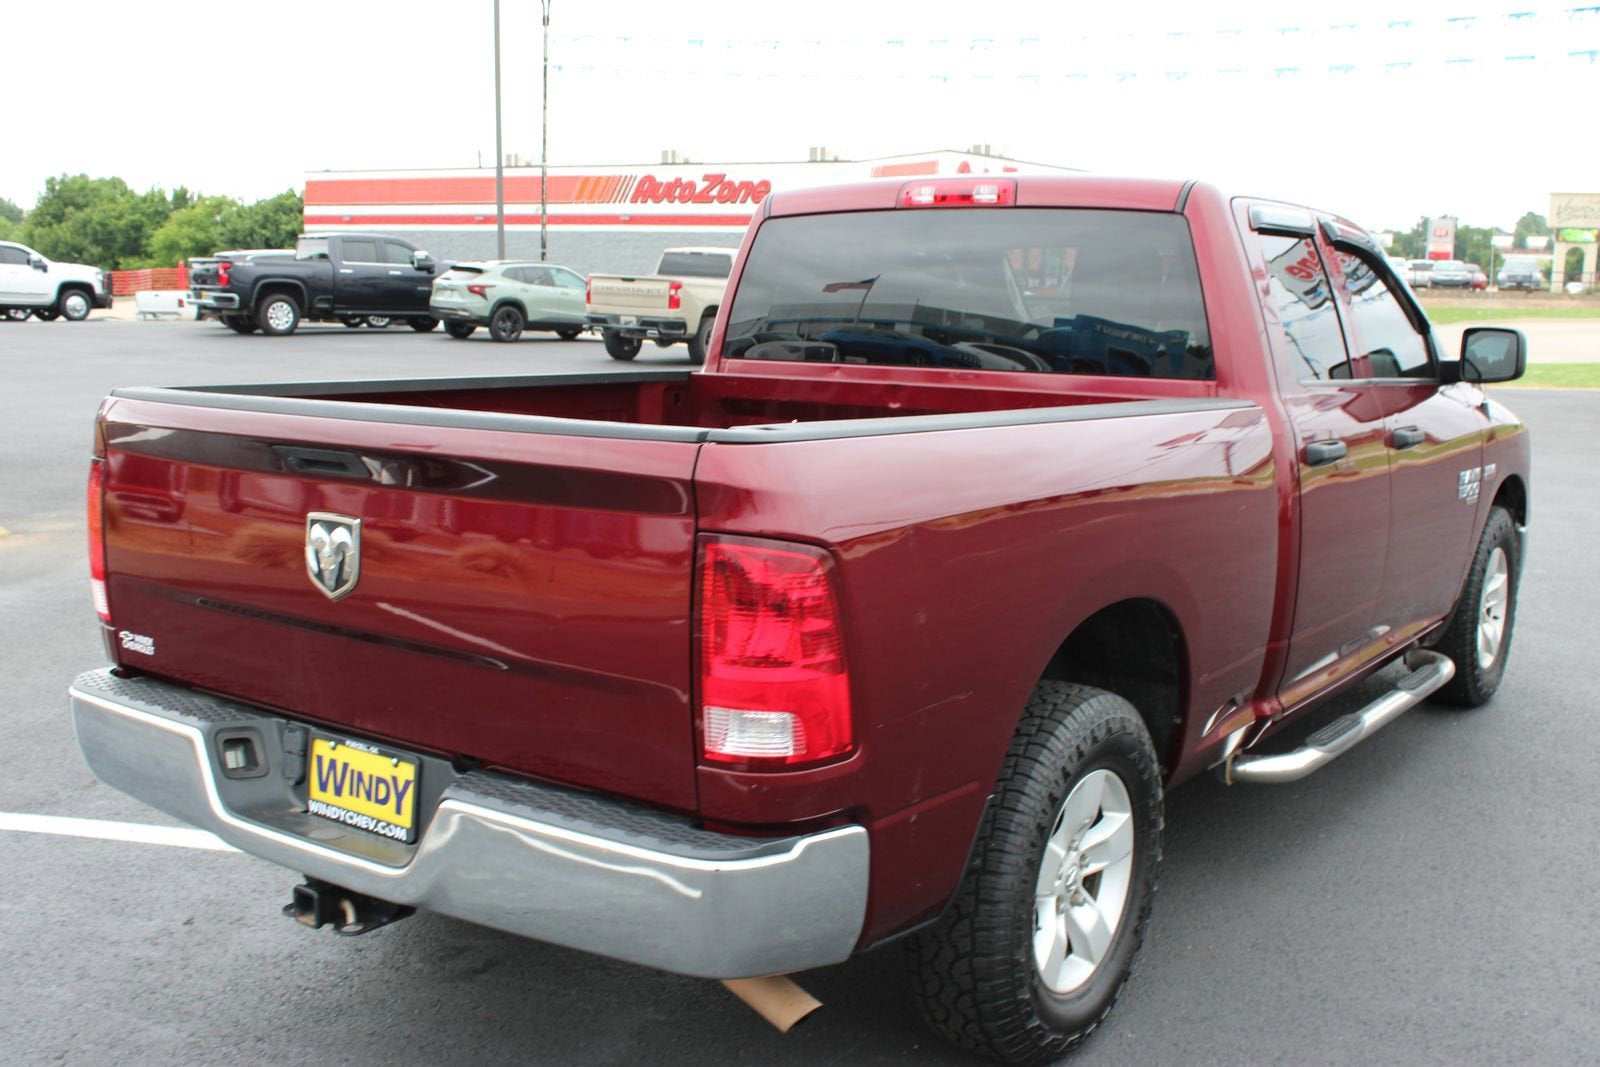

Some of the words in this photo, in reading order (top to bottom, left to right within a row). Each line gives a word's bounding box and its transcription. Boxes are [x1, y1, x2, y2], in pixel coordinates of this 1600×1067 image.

[630, 173, 771, 203] AutoZone
[594, 285, 661, 293] CHEVROLET
[316, 754, 414, 816] WINDY
[308, 799, 408, 842] WINDYCHEV.COM
